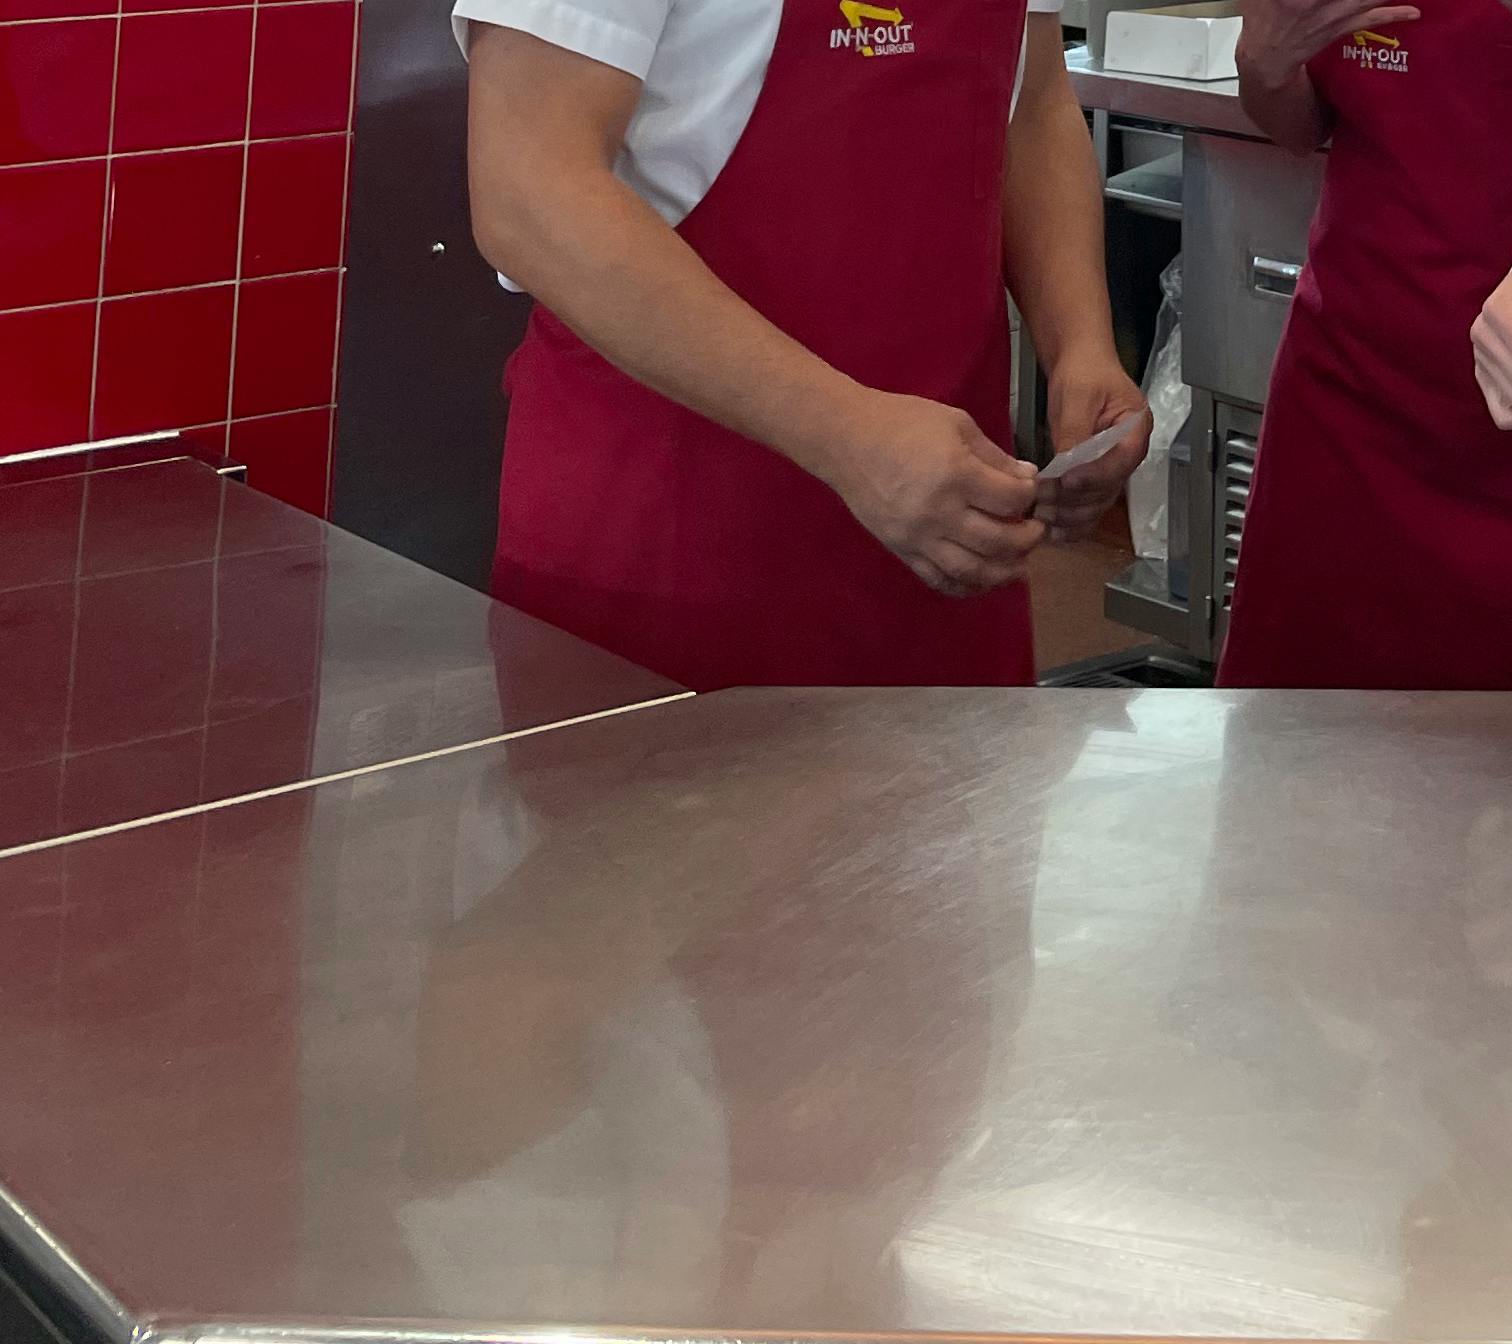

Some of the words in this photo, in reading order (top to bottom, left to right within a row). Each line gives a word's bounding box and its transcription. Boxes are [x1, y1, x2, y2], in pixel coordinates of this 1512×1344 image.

[830, 24, 913, 49] IN-N-OUT
[874, 42, 915, 56] BURGER
[1343, 45, 1409, 65] IN-N-OUT
